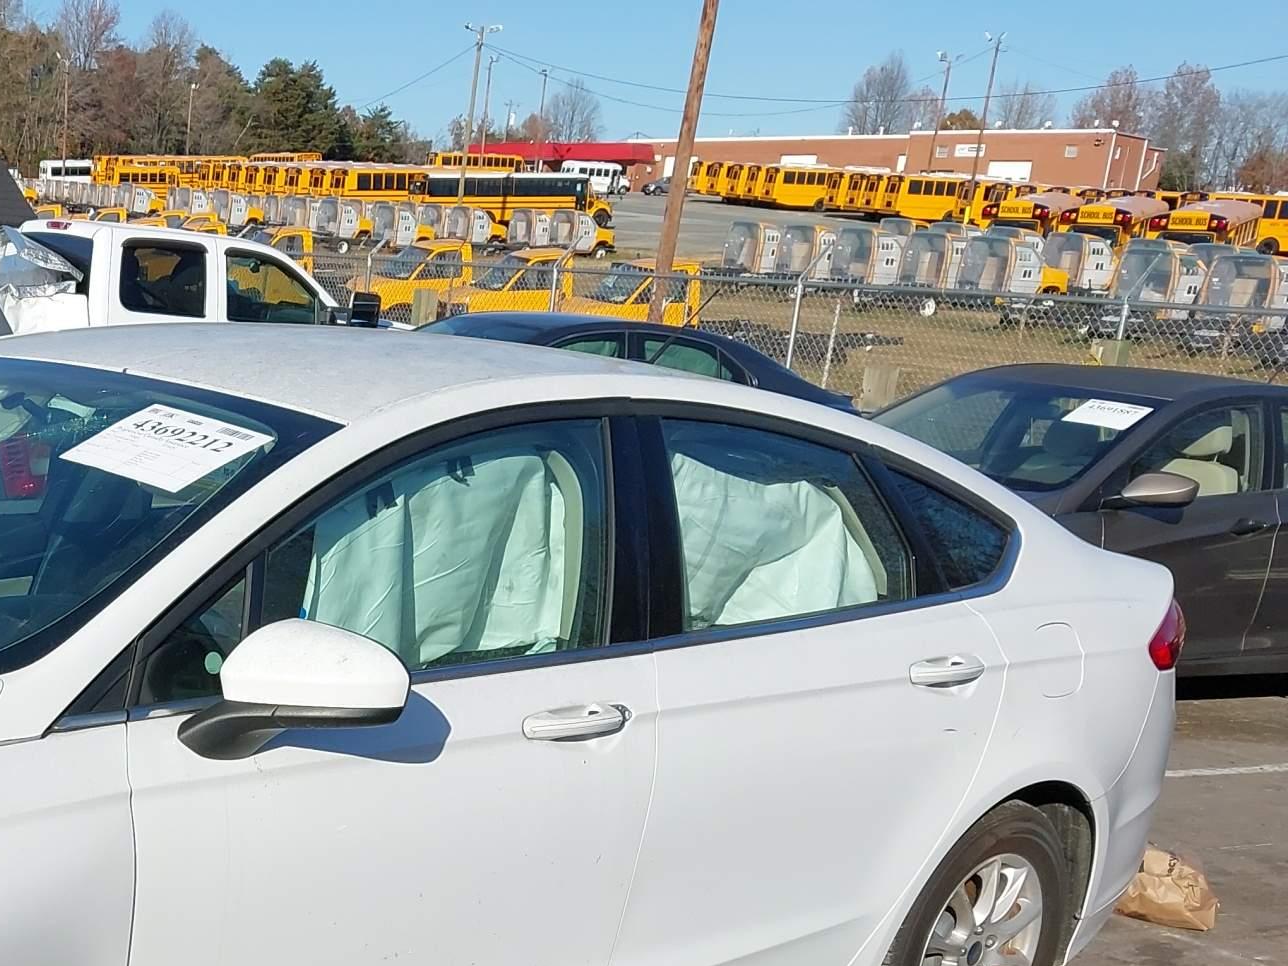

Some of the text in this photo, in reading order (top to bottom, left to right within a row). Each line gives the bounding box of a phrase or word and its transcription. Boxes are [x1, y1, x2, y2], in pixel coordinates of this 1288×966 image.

[1001, 205, 1032, 214] SCHOOL BUS
[1080, 211, 1114, 220] SCHOOL BUS
[1170, 216, 1208, 226] SCHOOL BUS
[132, 419, 234, 453] 43692212
